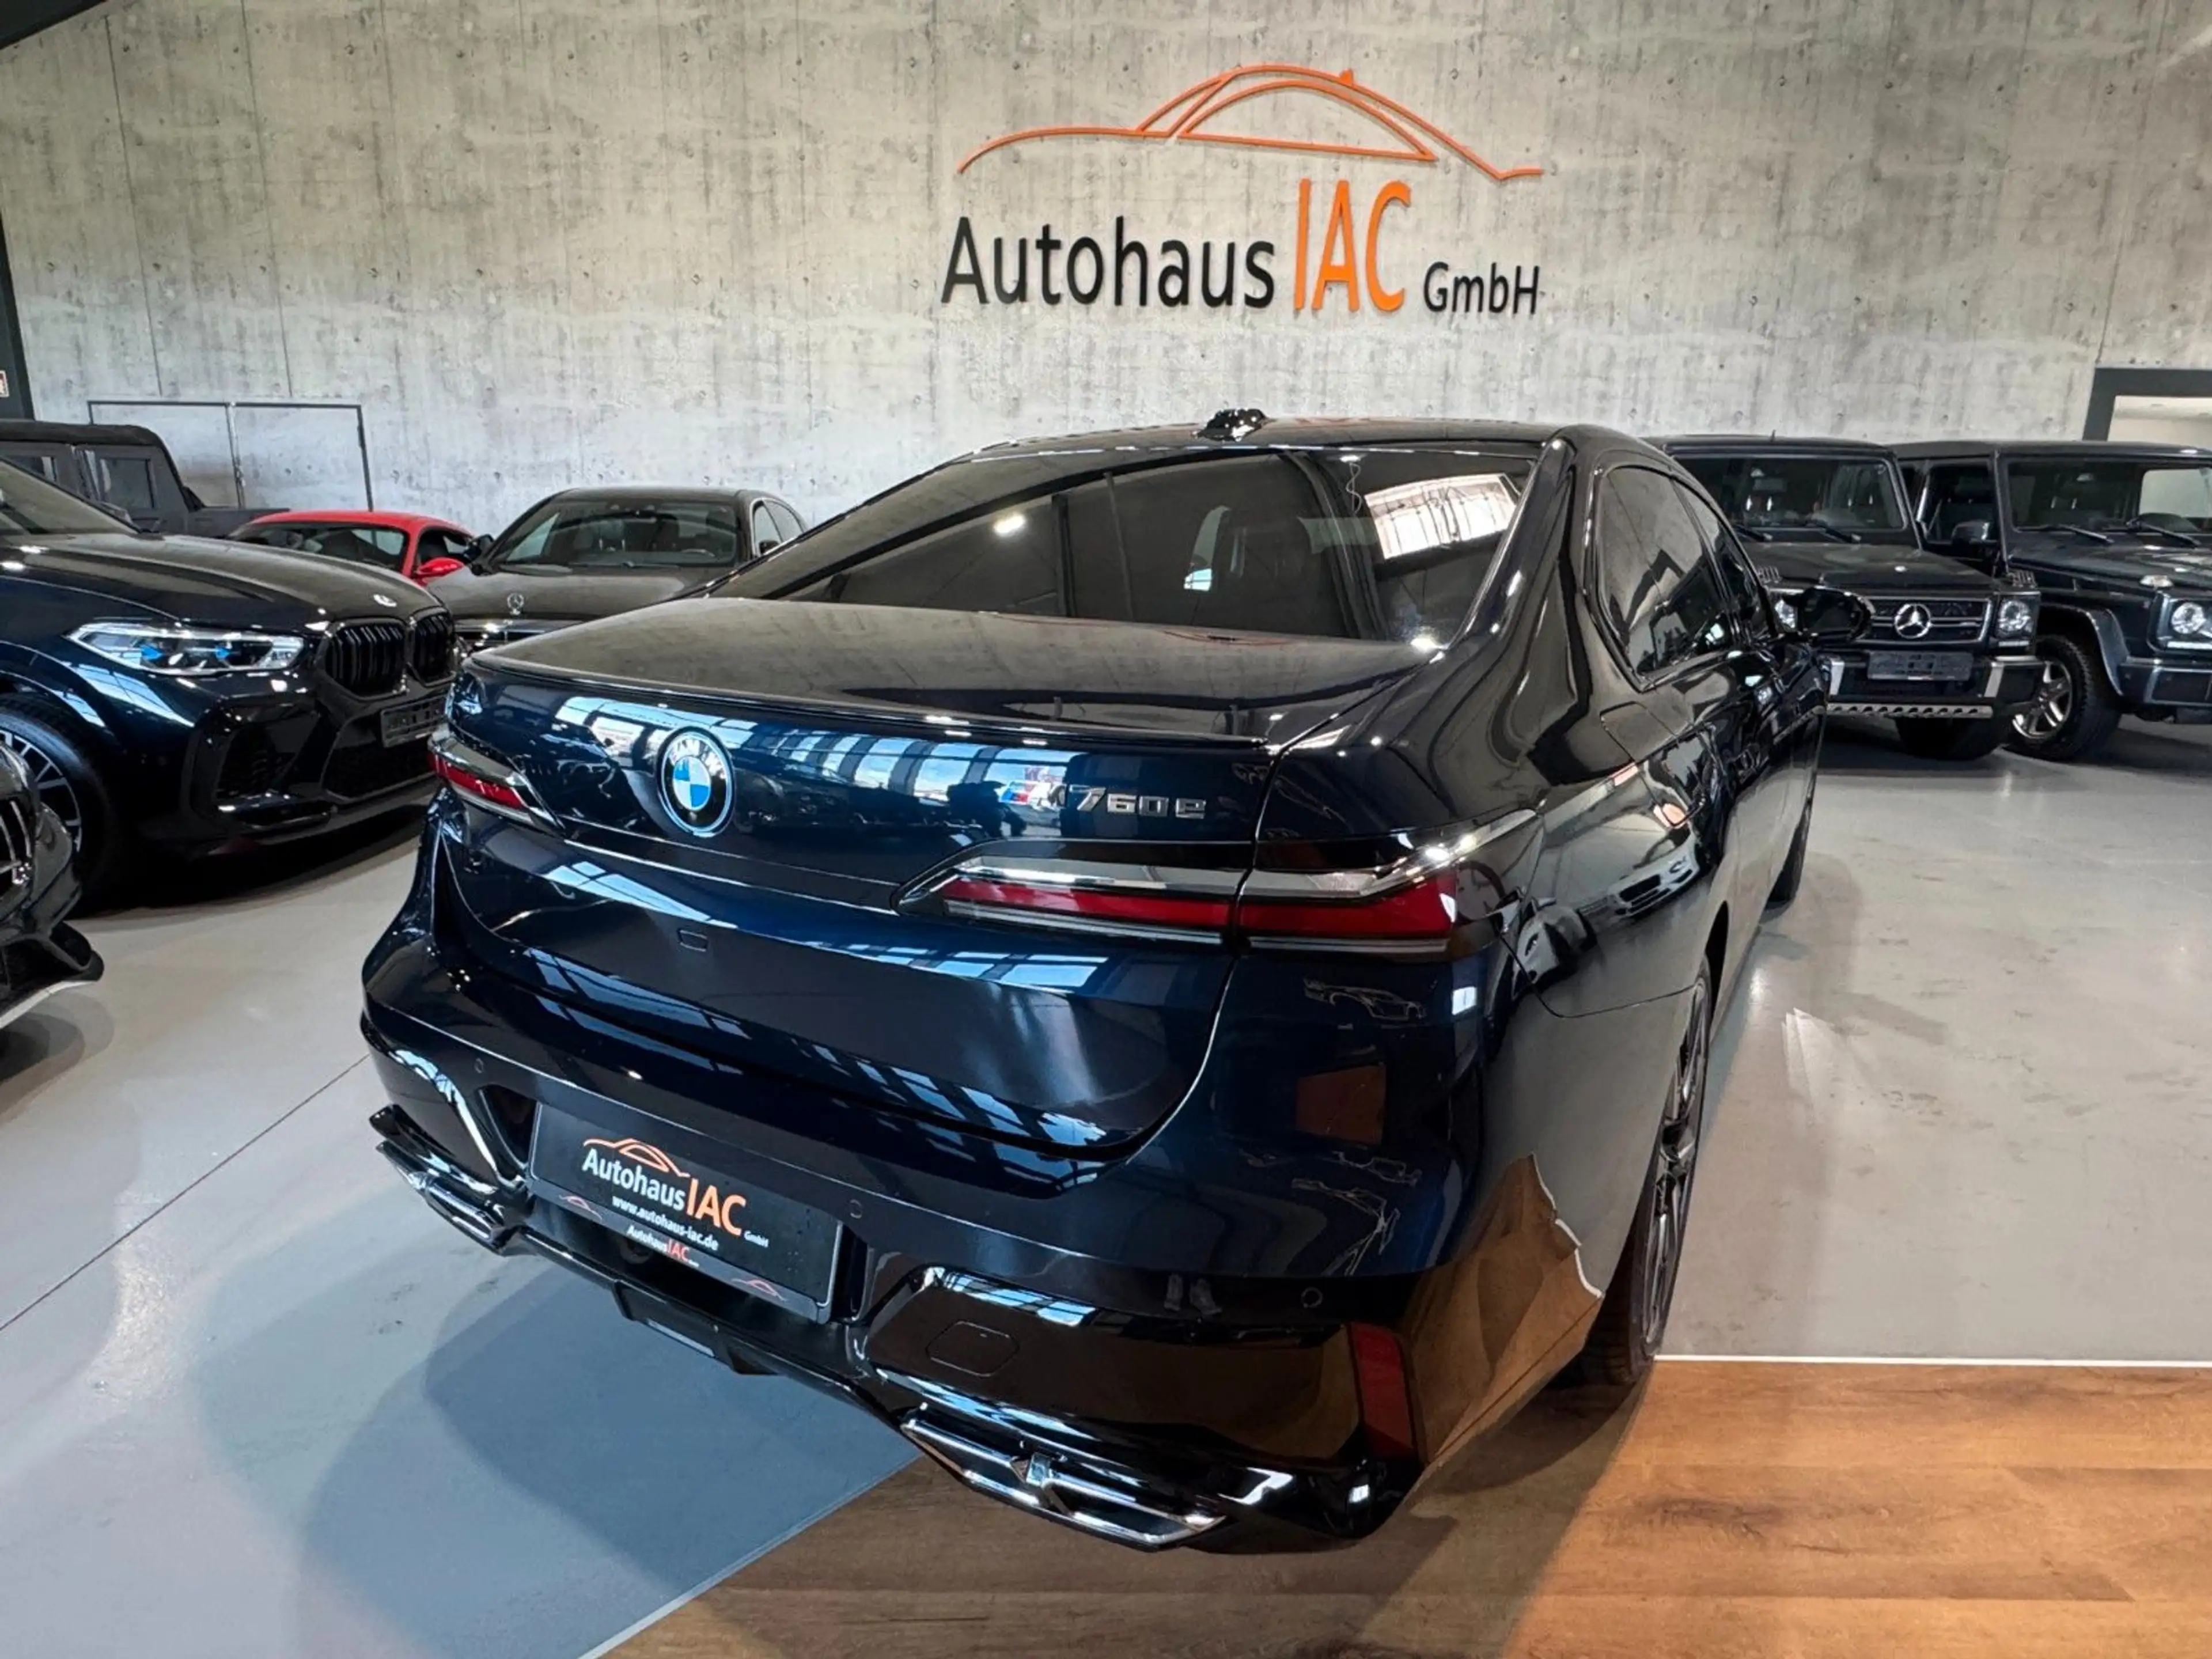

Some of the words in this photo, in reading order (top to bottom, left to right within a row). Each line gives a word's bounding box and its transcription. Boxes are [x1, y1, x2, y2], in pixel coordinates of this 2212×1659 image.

[941, 216, 1275, 309] Autohaus
[1294, 179, 1411, 312] IAC
[1423, 262, 1541, 315] GmbH
[582, 1148, 686, 1210] Autohaus
[686, 1178, 747, 1236] IAC
[744, 1229, 770, 1248] GmbH
[612, 1194, 719, 1252] www.autohaus-iac.de
[626, 1225, 668, 1253] Autohaus
[668, 1238, 690, 1262] IAC
